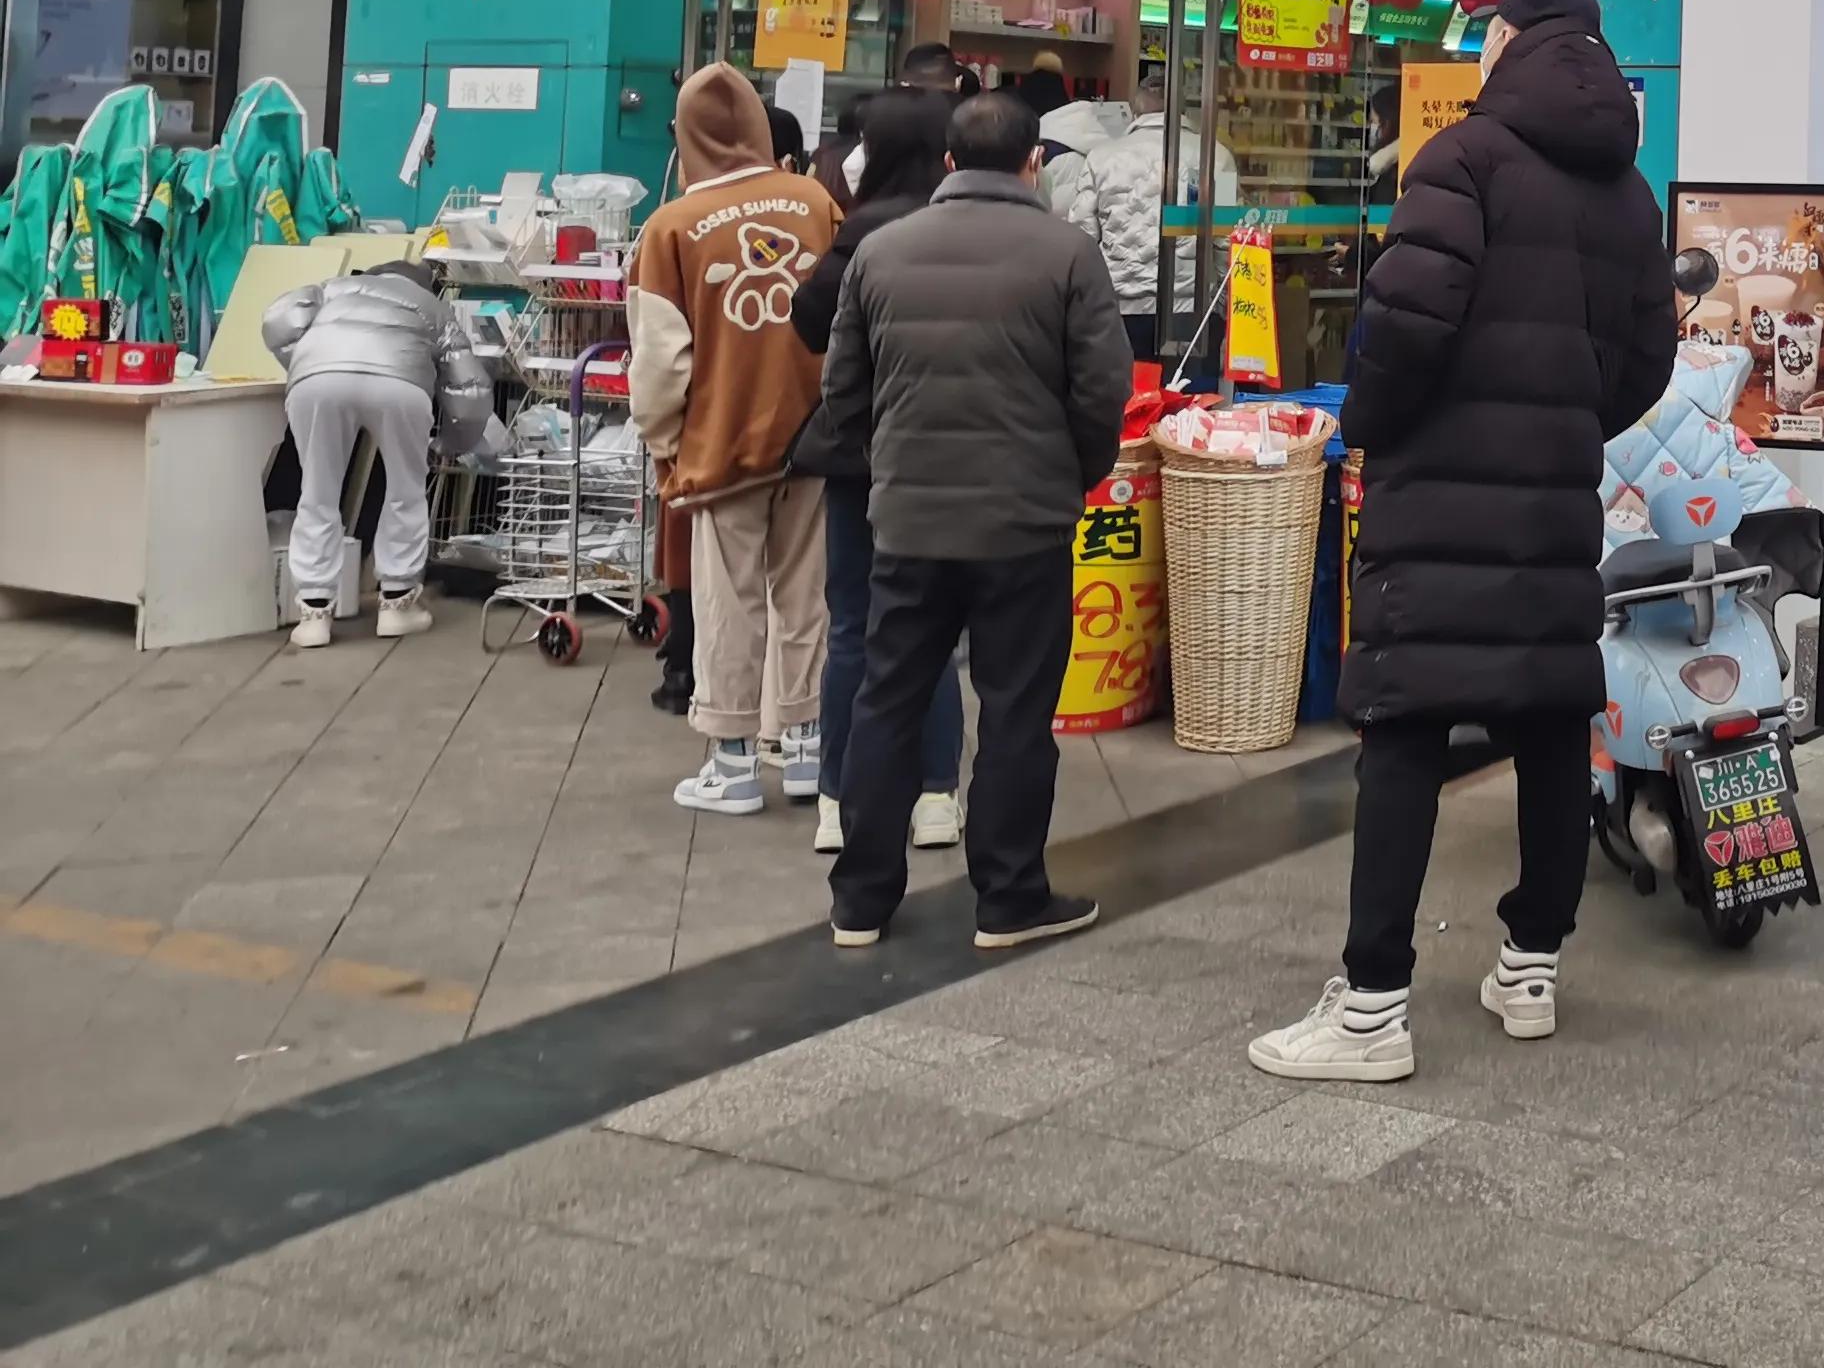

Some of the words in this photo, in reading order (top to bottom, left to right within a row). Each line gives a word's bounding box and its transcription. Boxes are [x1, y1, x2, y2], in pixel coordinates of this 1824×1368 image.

[687, 205, 742, 241] LOSER
[1079, 505, 1142, 561] 药
[1704, 767, 1780, 804] 365525
[1707, 794, 1782, 830] 八里庄
[1733, 814, 1798, 863] 雅迪
[1712, 850, 1802, 889] 丢车包赔
